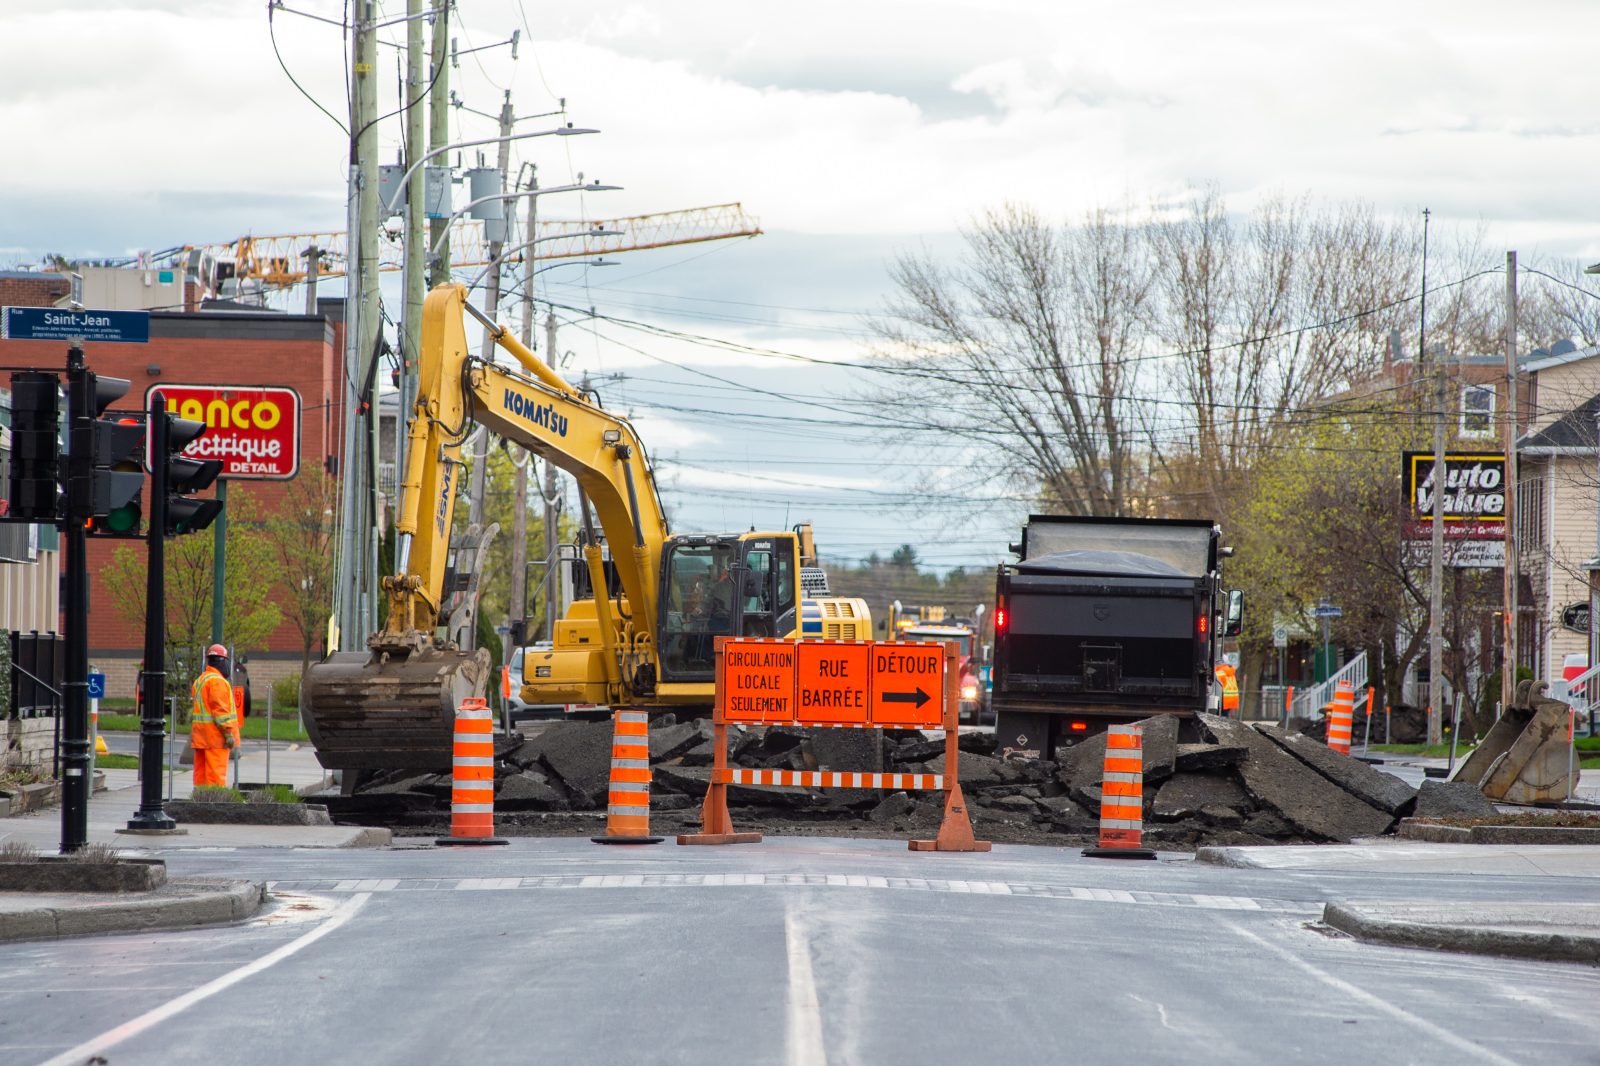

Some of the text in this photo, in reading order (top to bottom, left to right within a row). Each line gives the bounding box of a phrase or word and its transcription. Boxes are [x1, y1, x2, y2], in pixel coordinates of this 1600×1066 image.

[44, 312, 110, 326] Saint-Jean
[504, 388, 568, 437] KOMATSU
[185, 432, 281, 462] ectrique
[230, 462, 281, 473] DETAIL
[1416, 487, 1504, 513] Value
[728, 652, 792, 667] CIRCULATION
[877, 652, 937, 674] DÉTOUR
[819, 660, 849, 678] RUE
[737, 674, 780, 690] LOCALE
[731, 697, 788, 712] SEULEMENT
[802, 686, 863, 708] BARRÉE
